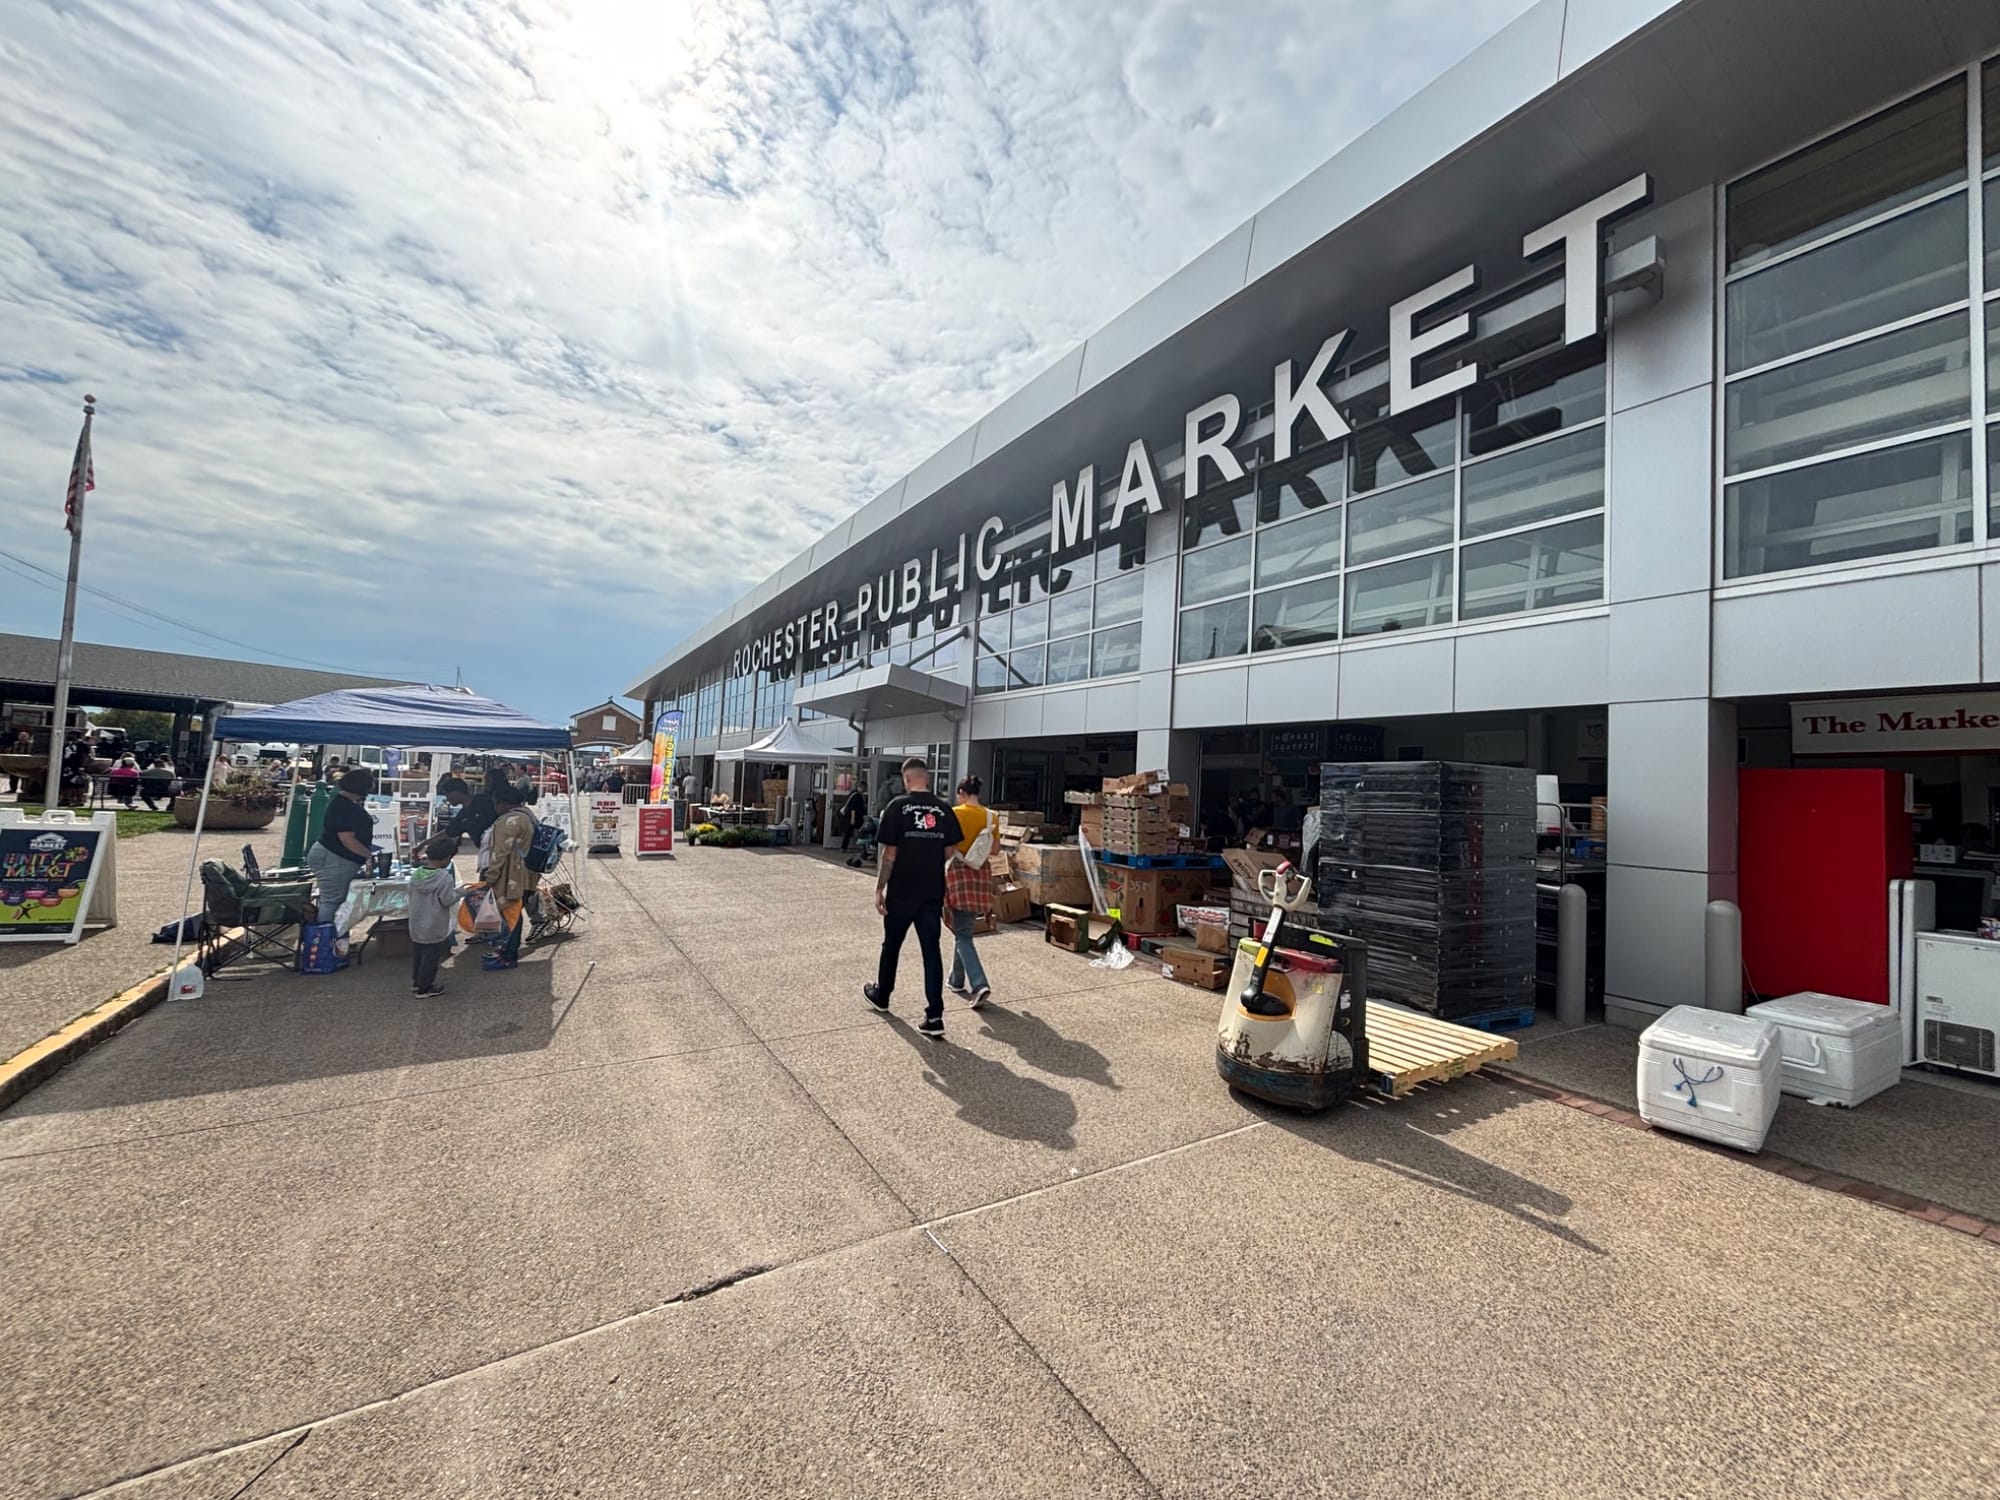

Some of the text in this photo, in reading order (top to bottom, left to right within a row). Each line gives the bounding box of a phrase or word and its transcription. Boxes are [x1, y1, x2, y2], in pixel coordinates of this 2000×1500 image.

[732, 171, 1649, 678] ROCHESTER PUBLIC MARKET
[1802, 715, 1867, 735] The
[29, 842, 67, 850] MARKET
[3, 853, 62, 869] UNITY
[6, 862, 76, 878] MARKET
